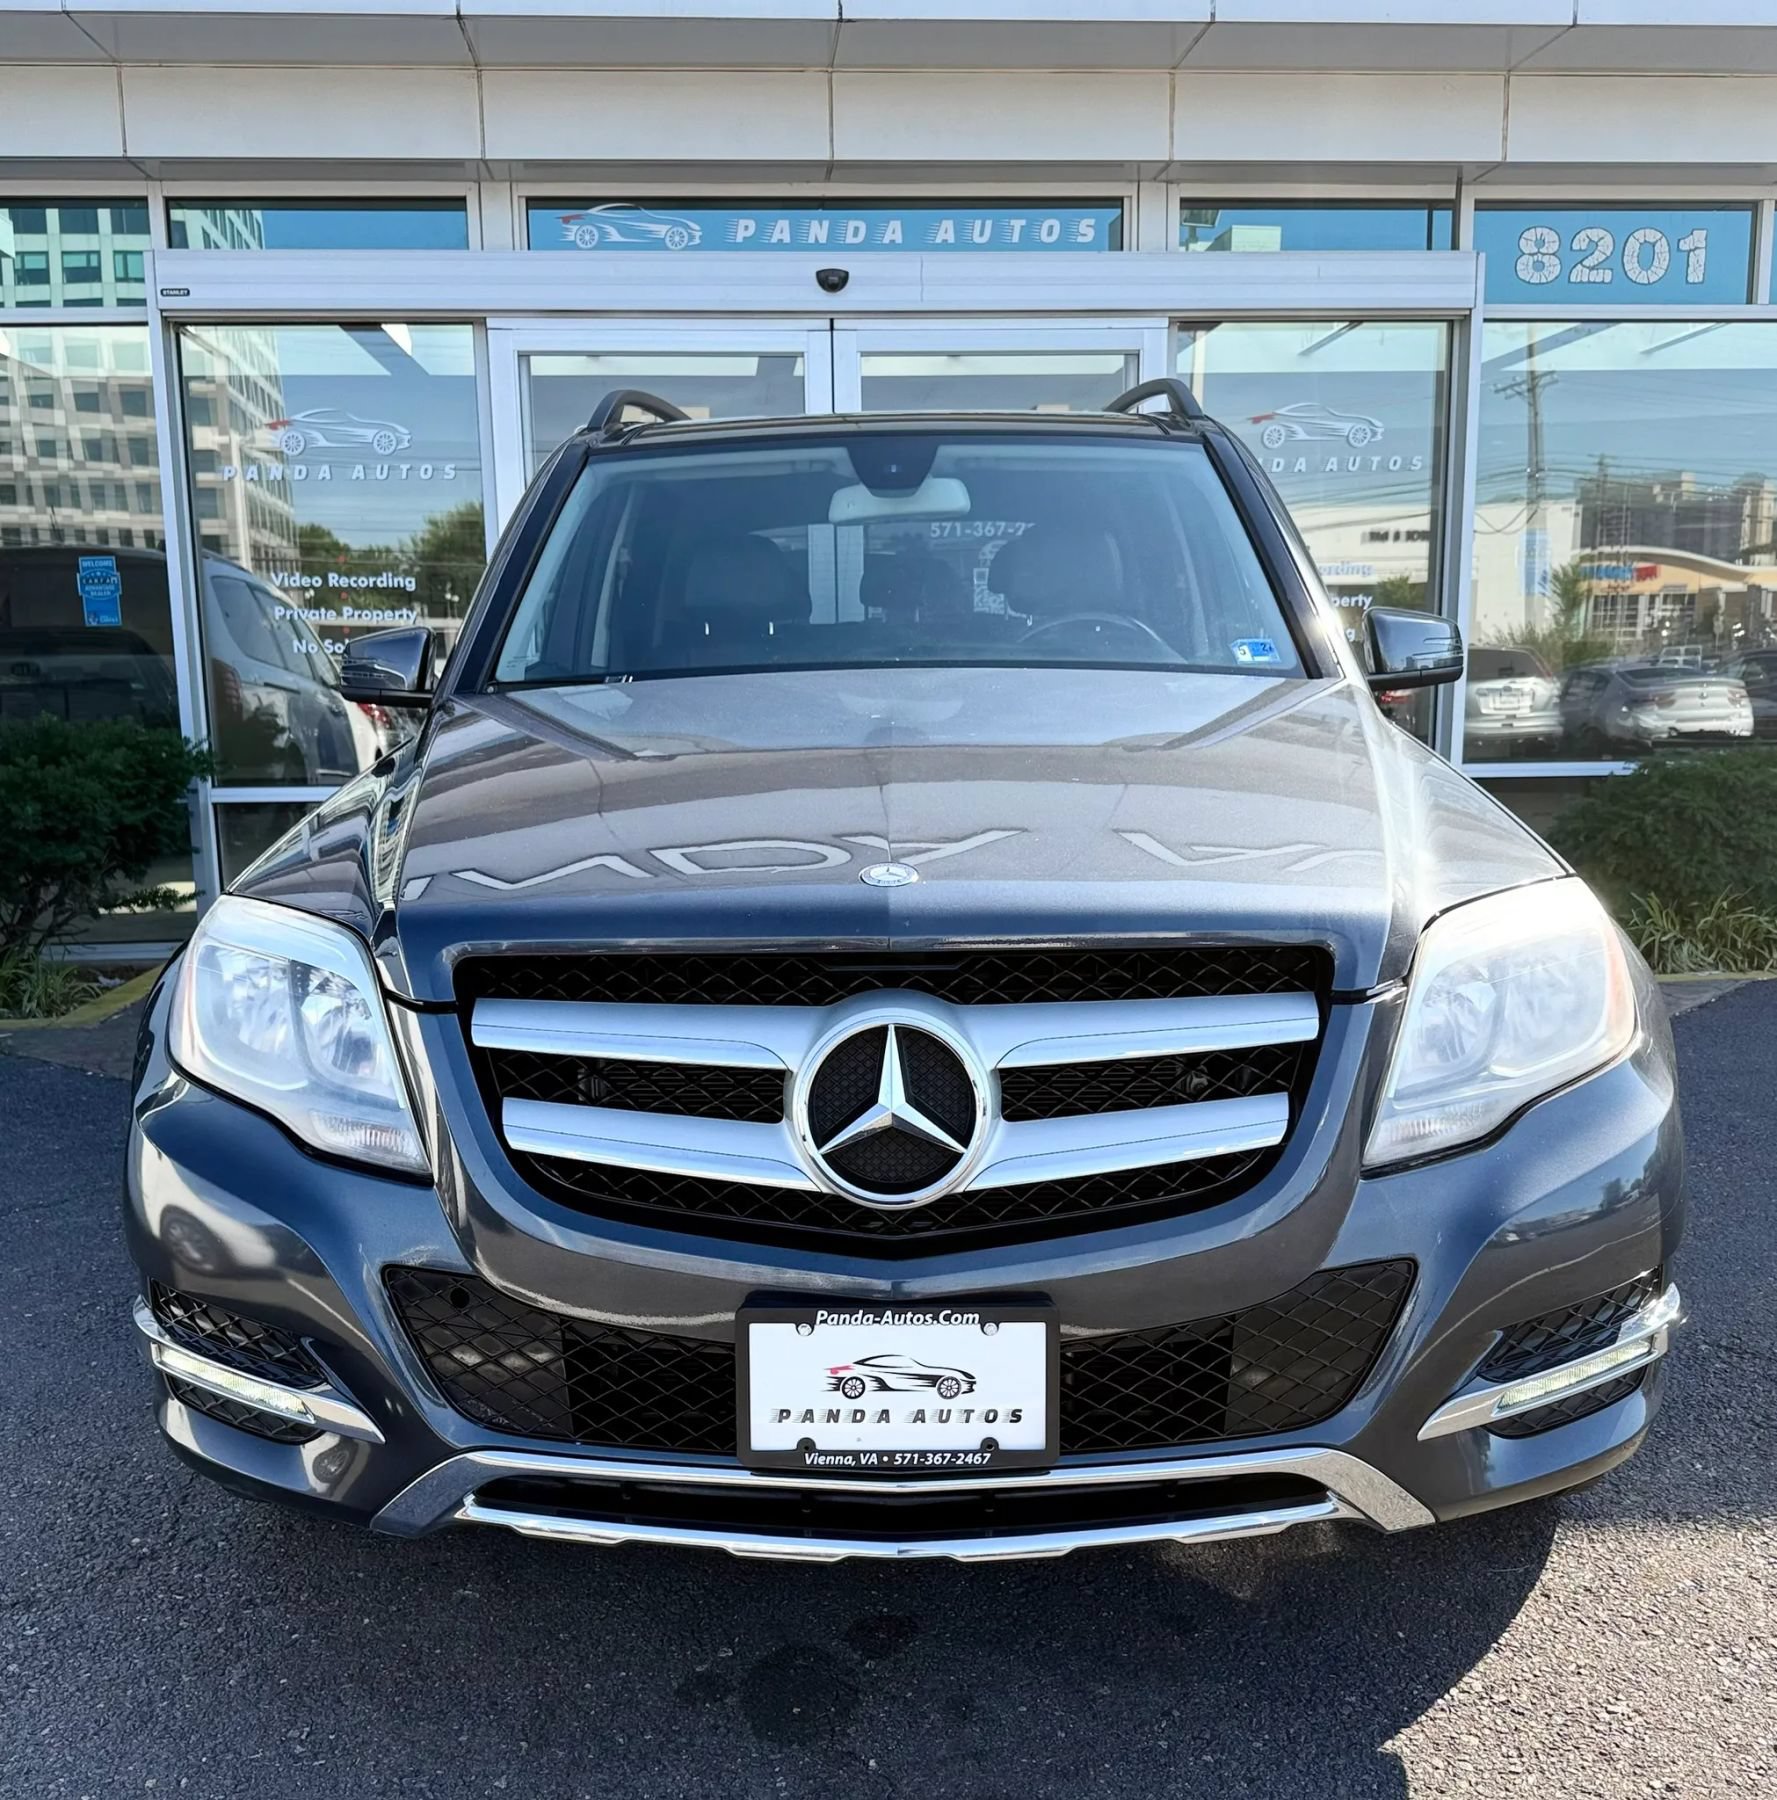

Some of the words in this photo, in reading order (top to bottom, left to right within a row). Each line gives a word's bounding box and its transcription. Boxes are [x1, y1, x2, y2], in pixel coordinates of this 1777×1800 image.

[725, 218, 903, 244] PANDA
[922, 218, 1096, 244] AUTOS
[1514, 225, 1708, 285] 8201
[223, 464, 332, 481] PANDA
[352, 463, 457, 480] AUTOS
[1324, 456, 1423, 472] AUTOS
[1318, 561, 1375, 576] ording
[271, 572, 323, 588] Video
[328, 571, 417, 591] Recording
[274, 606, 337, 621] Private
[342, 606, 418, 625] Property
[293, 640, 318, 654] No
[815, 1309, 980, 1326] Panda-Autos.Com
[769, 1408, 890, 1424] PANDA
[906, 1408, 1023, 1424] AUTOS
[804, 1452, 856, 1466] Vienna,
[860, 1453, 878, 1465] VA
[893, 1452, 992, 1465] 571-367-2467
